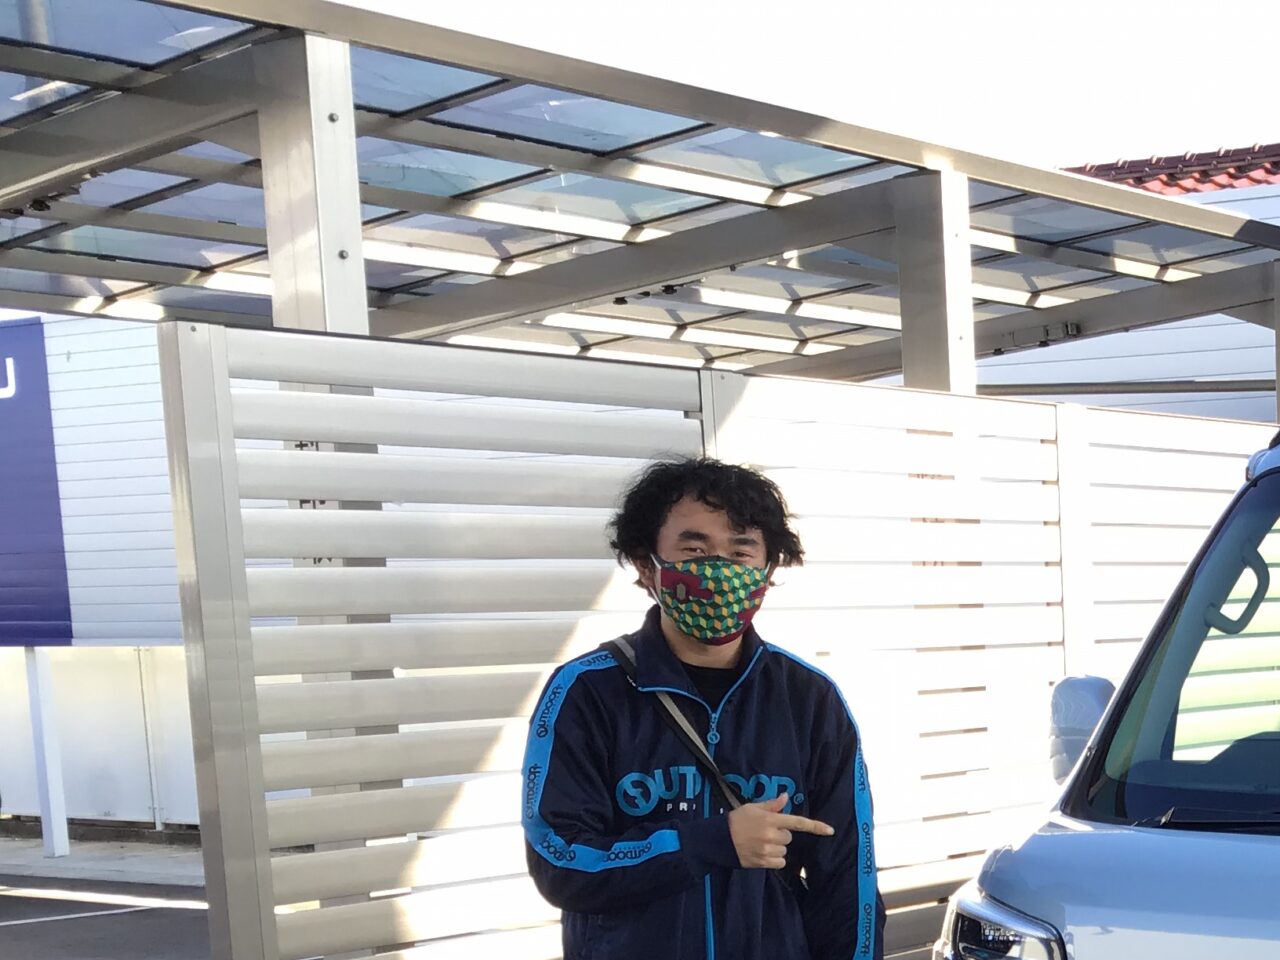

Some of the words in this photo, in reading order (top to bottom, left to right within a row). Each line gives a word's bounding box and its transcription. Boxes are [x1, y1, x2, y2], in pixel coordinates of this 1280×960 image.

[536, 685, 563, 738] OUTDOOR
[525, 764, 542, 820] OUTDOOR
[862, 822, 873, 876] OUTDOOR
[860, 902, 873, 957] OUTDOOR
